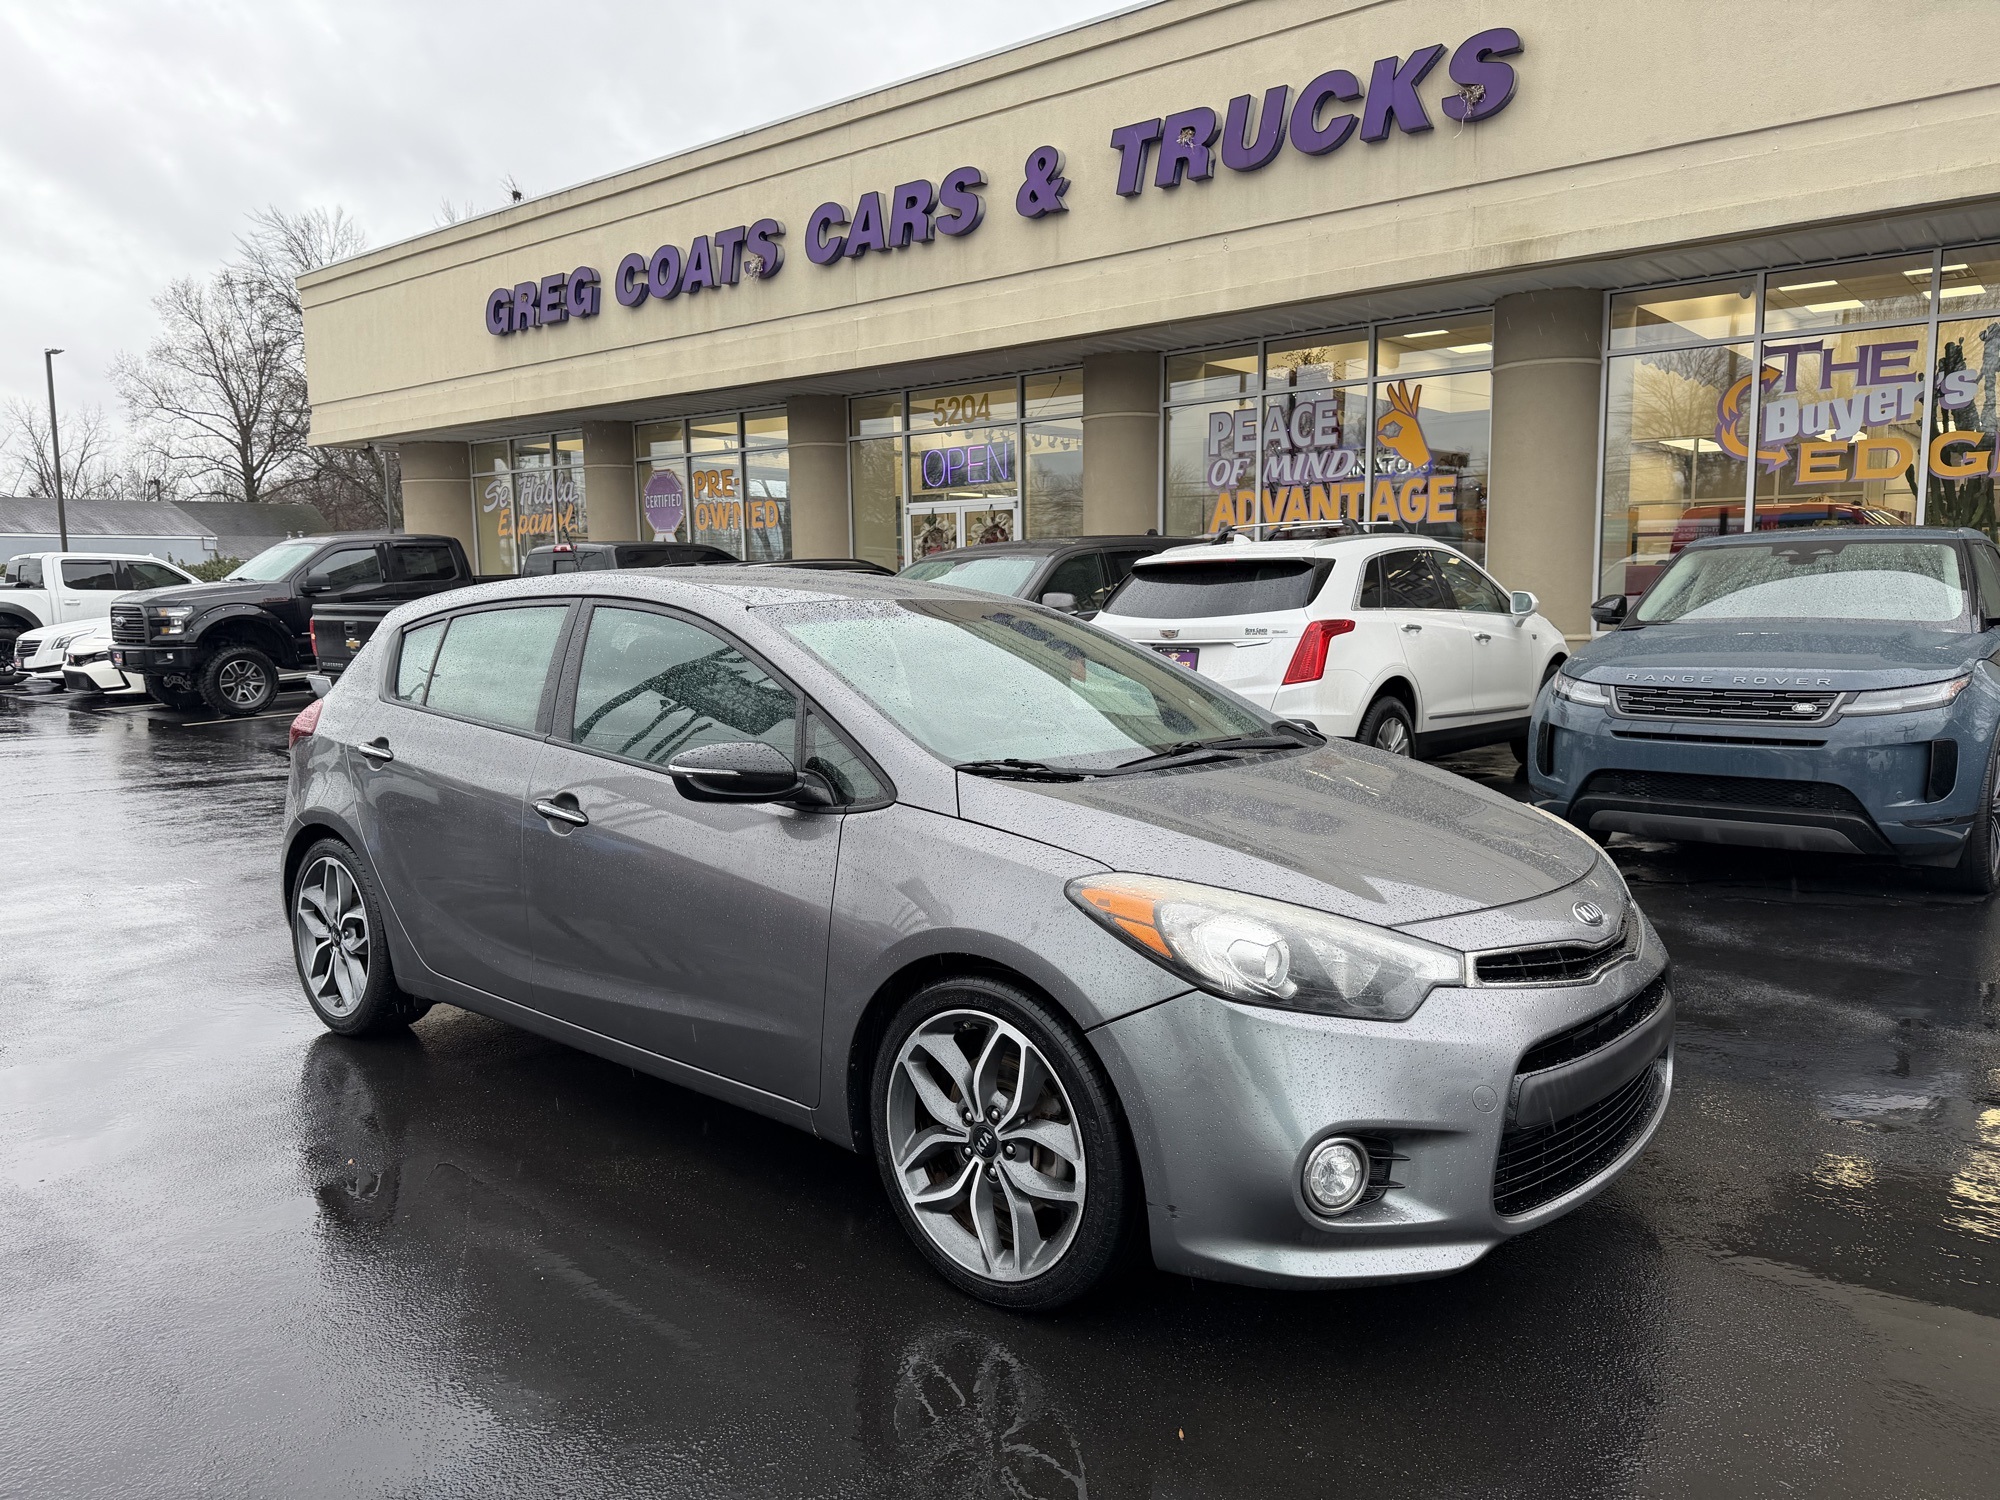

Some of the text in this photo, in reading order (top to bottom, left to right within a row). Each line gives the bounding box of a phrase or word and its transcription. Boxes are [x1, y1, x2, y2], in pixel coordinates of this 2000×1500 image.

[486, 27, 1525, 336] GREG COATS CARS & TRUCKS
[1763, 339, 1919, 395] THE
[933, 393, 990, 426] 5204
[1208, 399, 1340, 457] PEACE
[1762, 368, 1979, 446] Buyer's
[923, 442, 1008, 487] OPEN
[1208, 458, 1250, 490] OF
[1262, 449, 1356, 485] MIND
[1794, 430, 2000, 486] EDG
[483, 468, 580, 513] Se Habla
[645, 493, 682, 509] CERTIFIED
[692, 468, 740, 499] PRE-
[1208, 475, 1457, 534] ADVANTAGE
[694, 499, 780, 531] OWNED
[1625, 673, 1831, 686] RANGE ROVER
[1576, 903, 1602, 921] KIA
[976, 1132, 993, 1153] KIA
